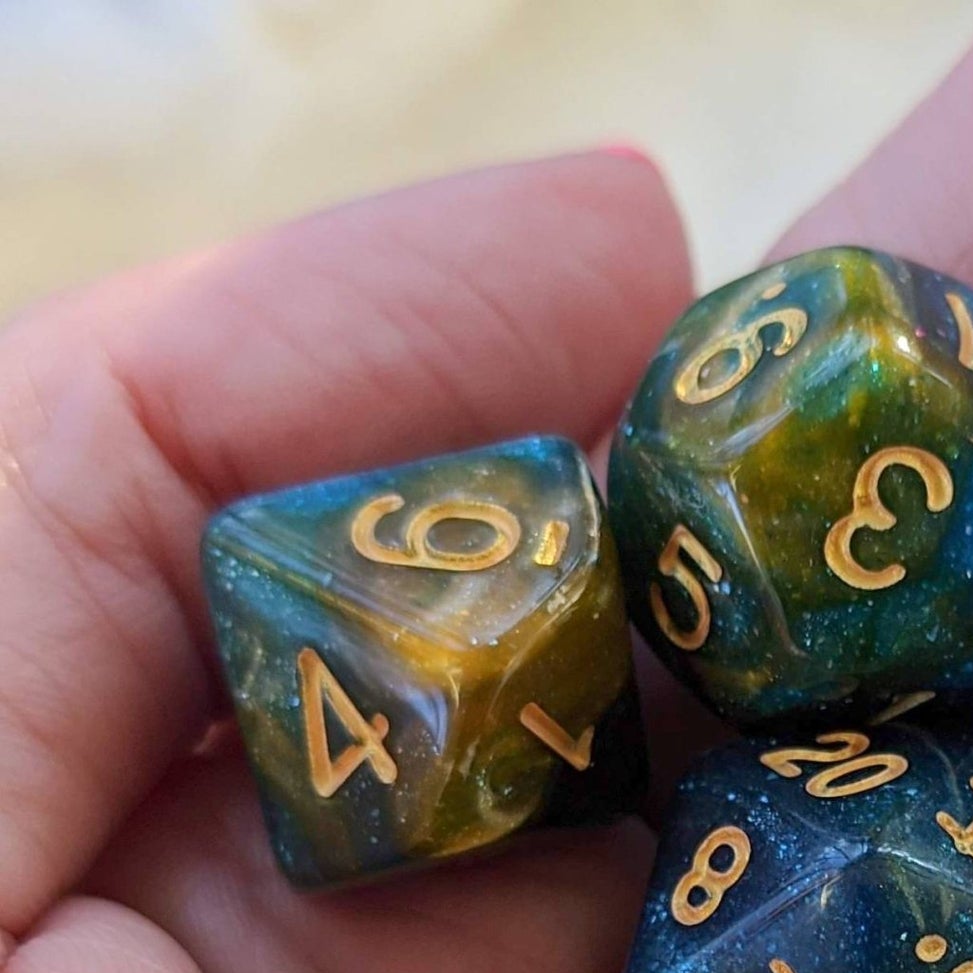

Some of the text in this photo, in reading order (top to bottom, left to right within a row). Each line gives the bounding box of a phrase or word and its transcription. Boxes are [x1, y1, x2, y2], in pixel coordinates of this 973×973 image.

[824, 446, 954, 590] 3
[651, 525, 724, 651] 5
[300, 649, 397, 797] 4
[760, 733, 909, 797] 20
[671, 826, 751, 926] 8
